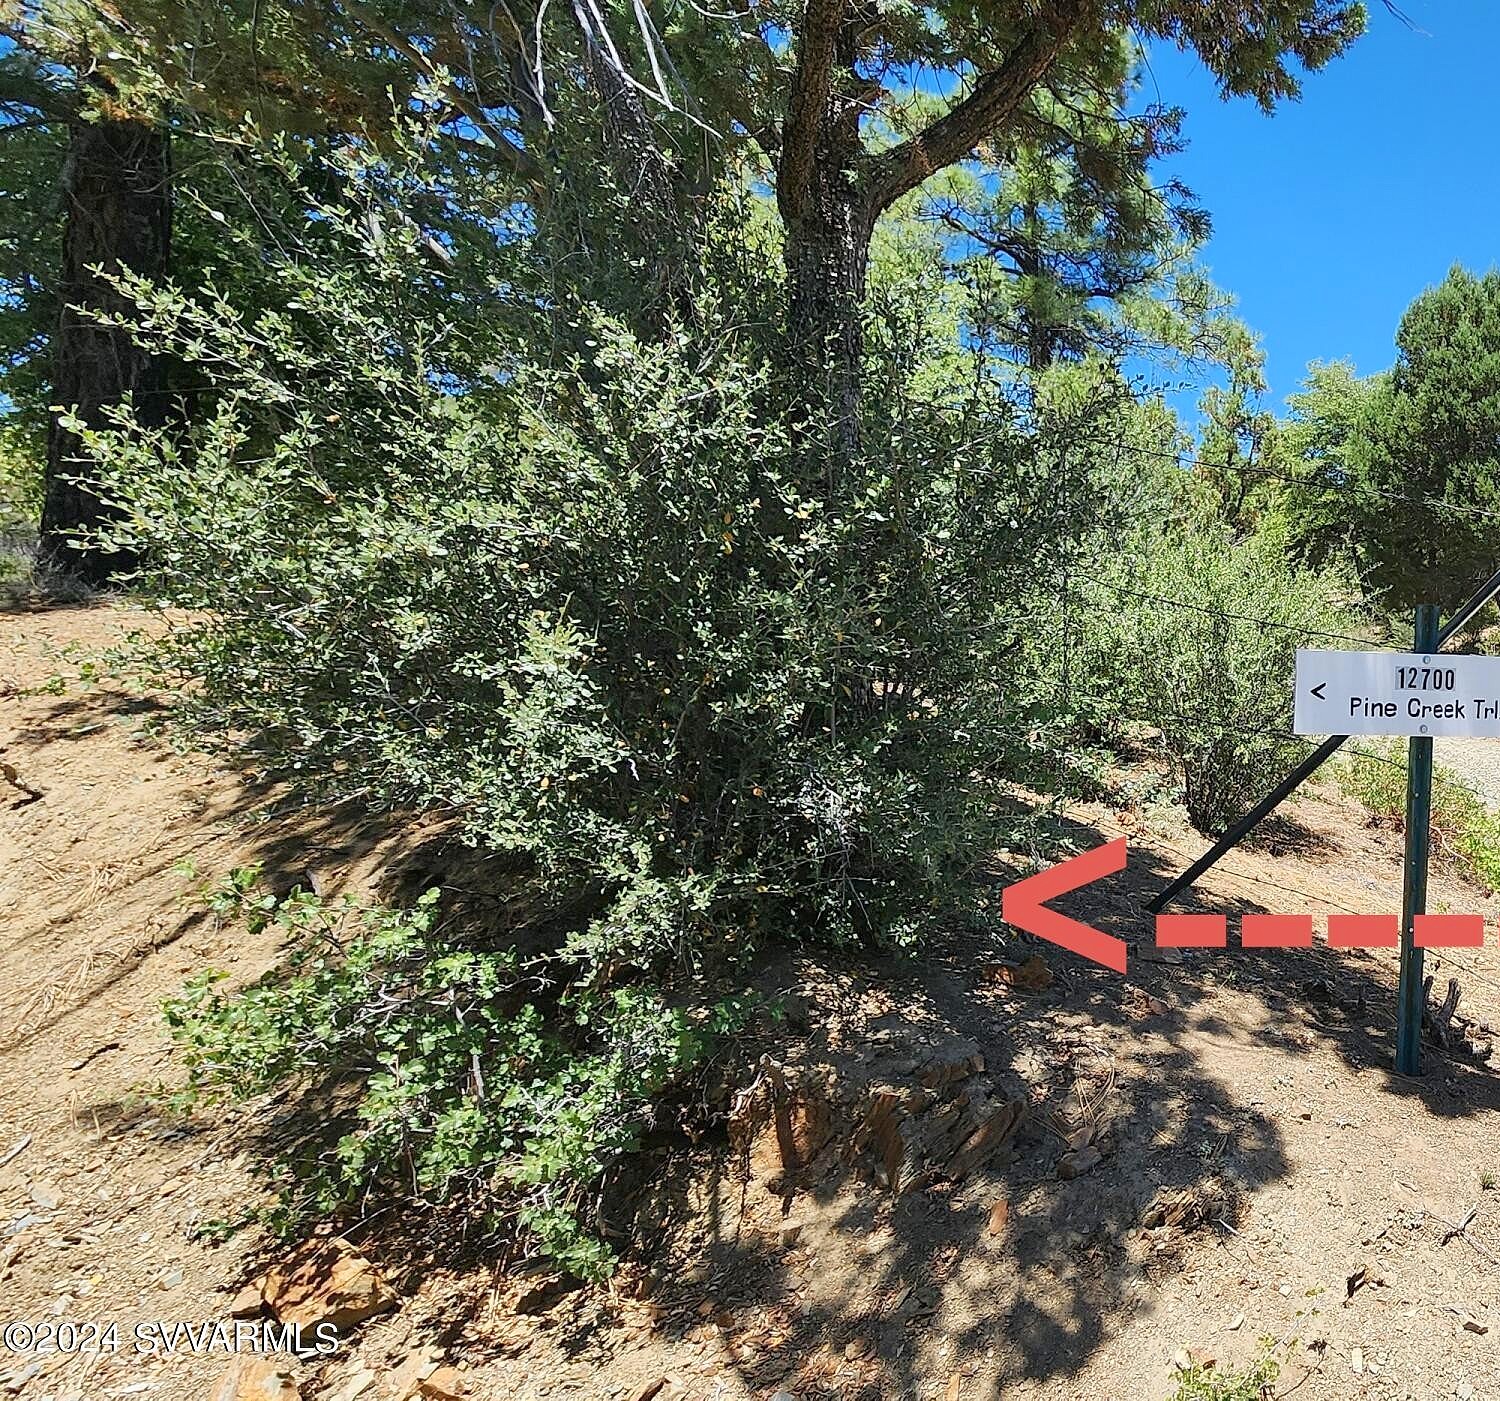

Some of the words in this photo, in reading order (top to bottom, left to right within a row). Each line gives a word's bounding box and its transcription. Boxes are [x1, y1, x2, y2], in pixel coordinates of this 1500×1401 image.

[1397, 667, 1456, 691] 12700
[1349, 697, 1398, 718] Pine
[1407, 697, 1466, 719] Creek
